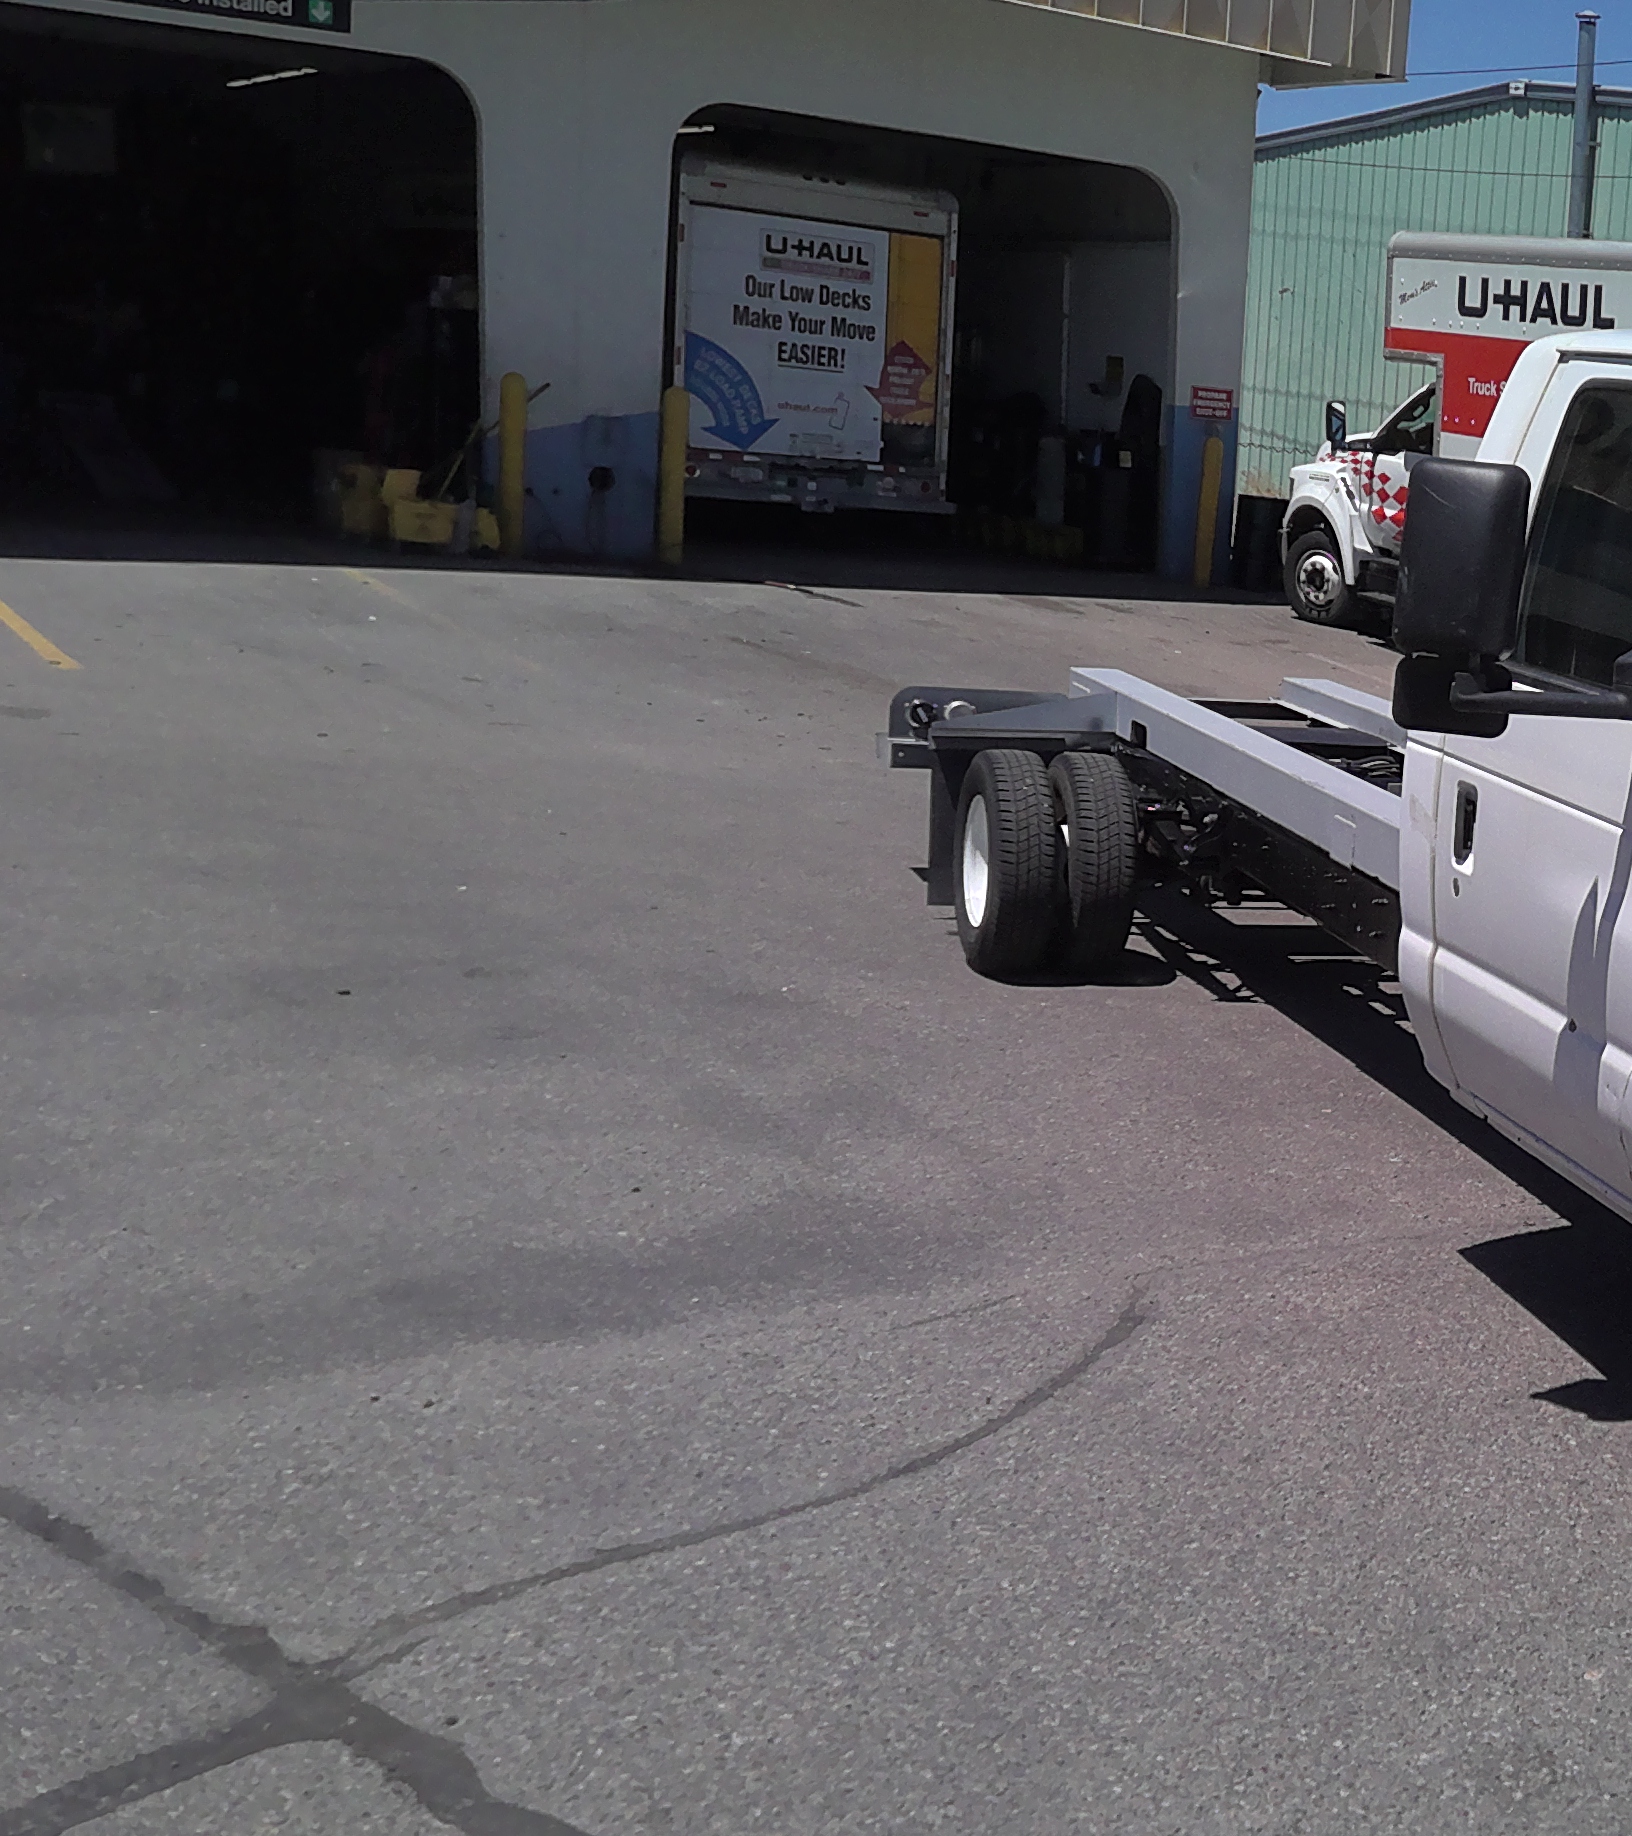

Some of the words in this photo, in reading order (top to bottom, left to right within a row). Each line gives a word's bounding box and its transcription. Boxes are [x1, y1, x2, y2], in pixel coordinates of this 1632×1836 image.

[766, 233, 869, 266] U-HAUL
[745, 274, 775, 299] Our
[780, 279, 814, 304] Low
[819, 284, 872, 311] Decks
[1458, 275, 1615, 329] U-HAUL
[732, 304, 783, 331] Make
[788, 310, 826, 336] Your
[830, 316, 876, 342] Move
[777, 341, 846, 369] EASIER!
[1467, 377, 1498, 397] Truck
